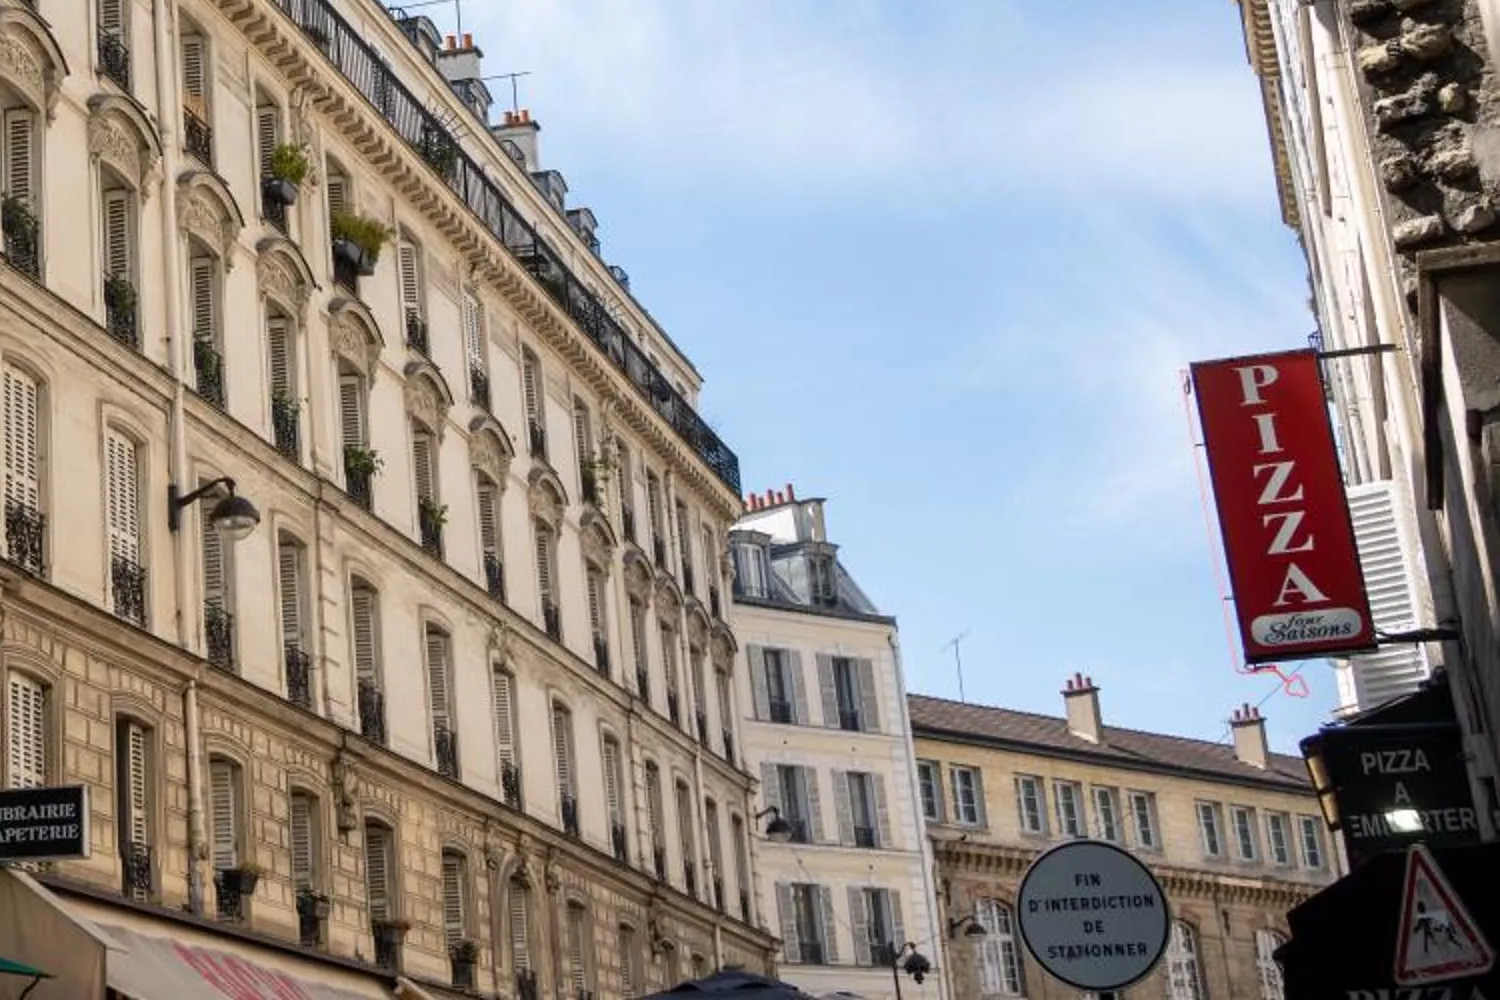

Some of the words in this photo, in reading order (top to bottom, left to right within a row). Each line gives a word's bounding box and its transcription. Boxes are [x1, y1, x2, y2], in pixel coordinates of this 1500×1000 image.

[1233, 364, 1331, 607] PIZZA
[1264, 622, 1354, 643] Saisons
[1361, 748, 1430, 774] PIZZA
[1394, 781, 1411, 804] A
[1349, 806, 1477, 839] EMRTER
[1074, 872, 1101, 887] FIN
[1028, 894, 1155, 913] D'INTERDICTION
[1083, 919, 1105, 935] DE
[1047, 942, 1149, 961] STATIONNER
